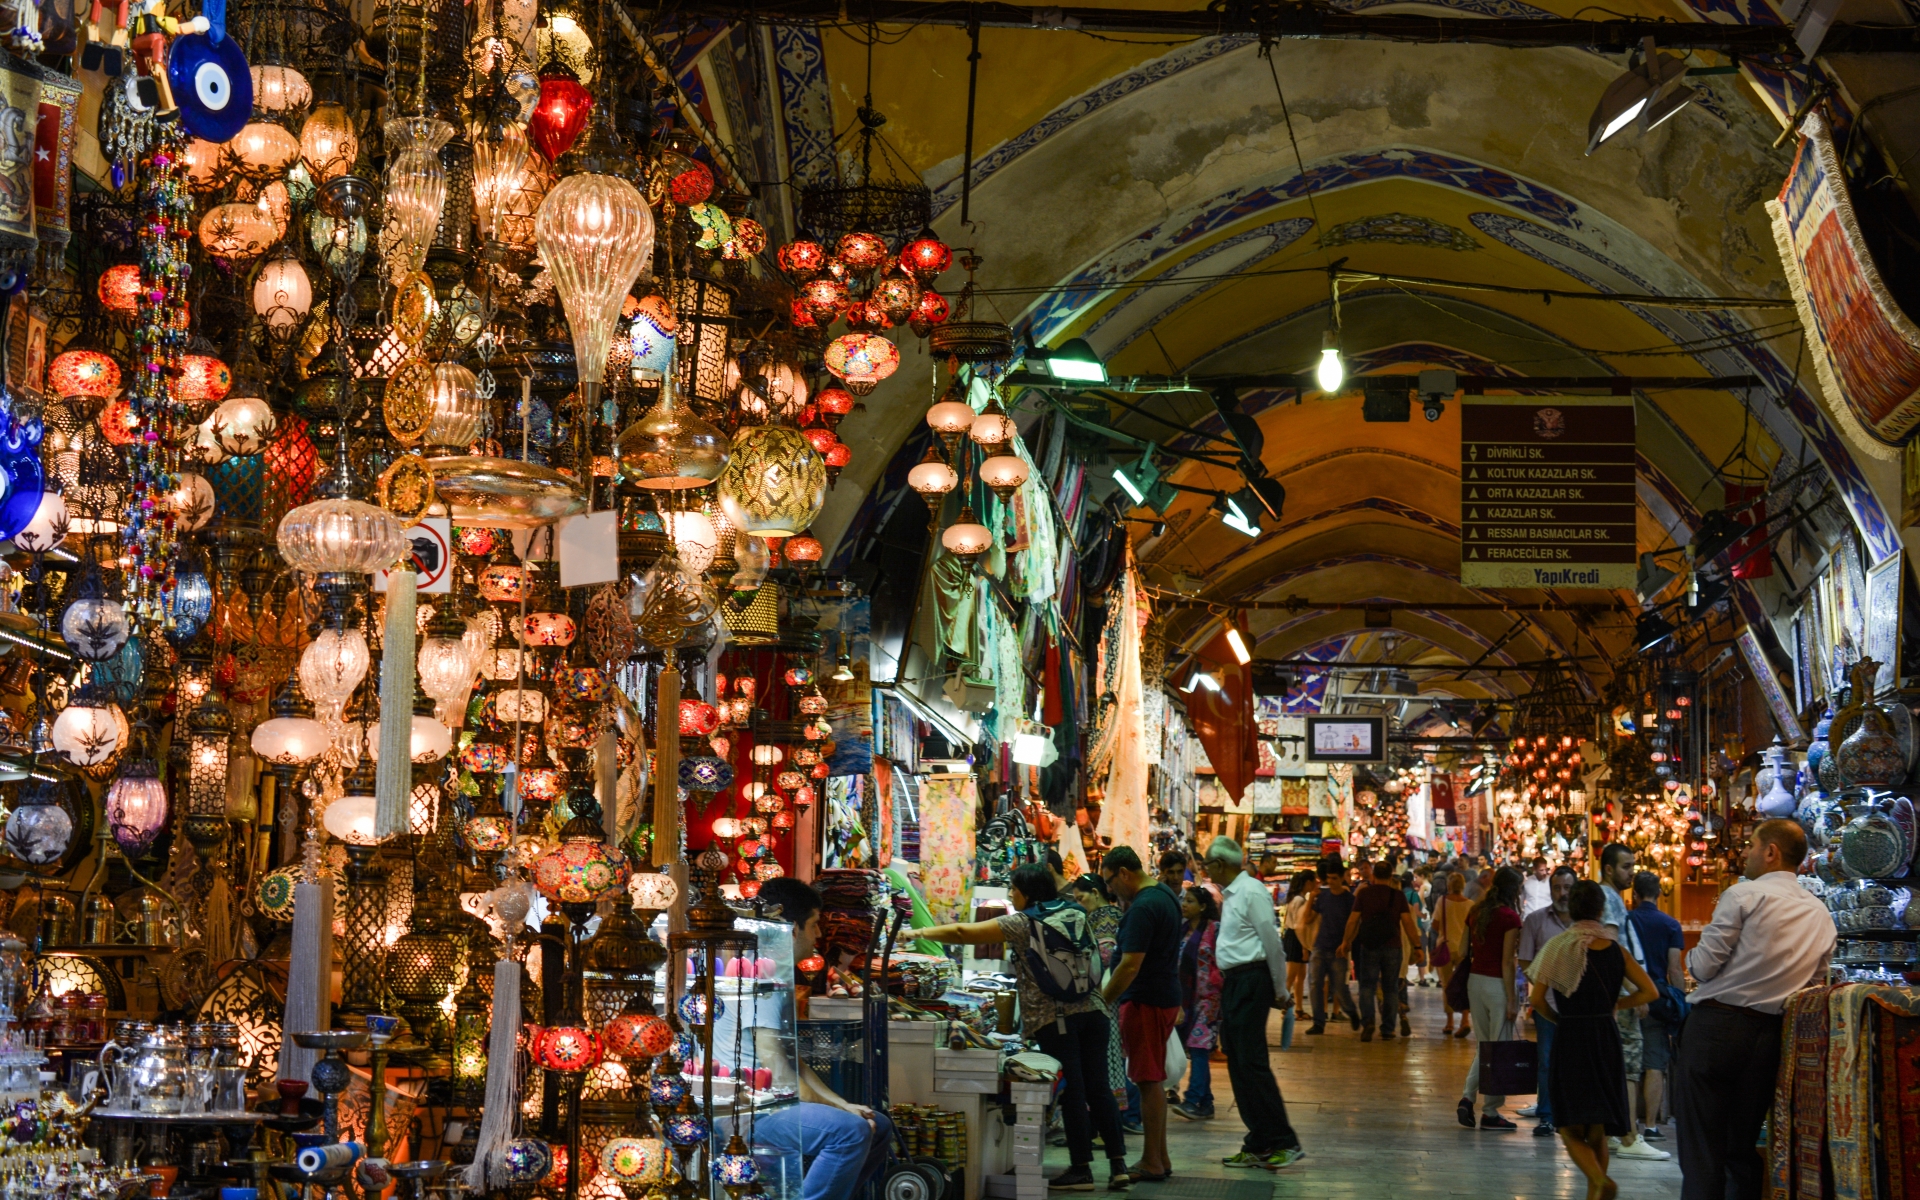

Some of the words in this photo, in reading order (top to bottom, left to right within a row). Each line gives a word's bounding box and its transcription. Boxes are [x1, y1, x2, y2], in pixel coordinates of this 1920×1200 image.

[1487, 446, 1526, 458] DİVRİKLİ
[1529, 449, 1544, 459] SK.
[1488, 468, 1525, 478] KOLTUK
[1529, 469, 1578, 479] KAZAZLAR
[1581, 469, 1596, 479] SK.
[1487, 488, 1513, 498] ORTA
[1516, 489, 1566, 499] KAZAZLAR
[1569, 489, 1584, 499] SK.
[1488, 509, 1537, 519] KAZAZLAR
[1540, 509, 1555, 519] SK.
[1488, 529, 1527, 539] RESSAM
[1530, 529, 1591, 539] BASMACILAR
[1594, 529, 1609, 539] SK.
[1488, 547, 1553, 558] FERACECİLER
[1556, 549, 1571, 559] SK.
[1534, 569, 1599, 585] YapıKredi
